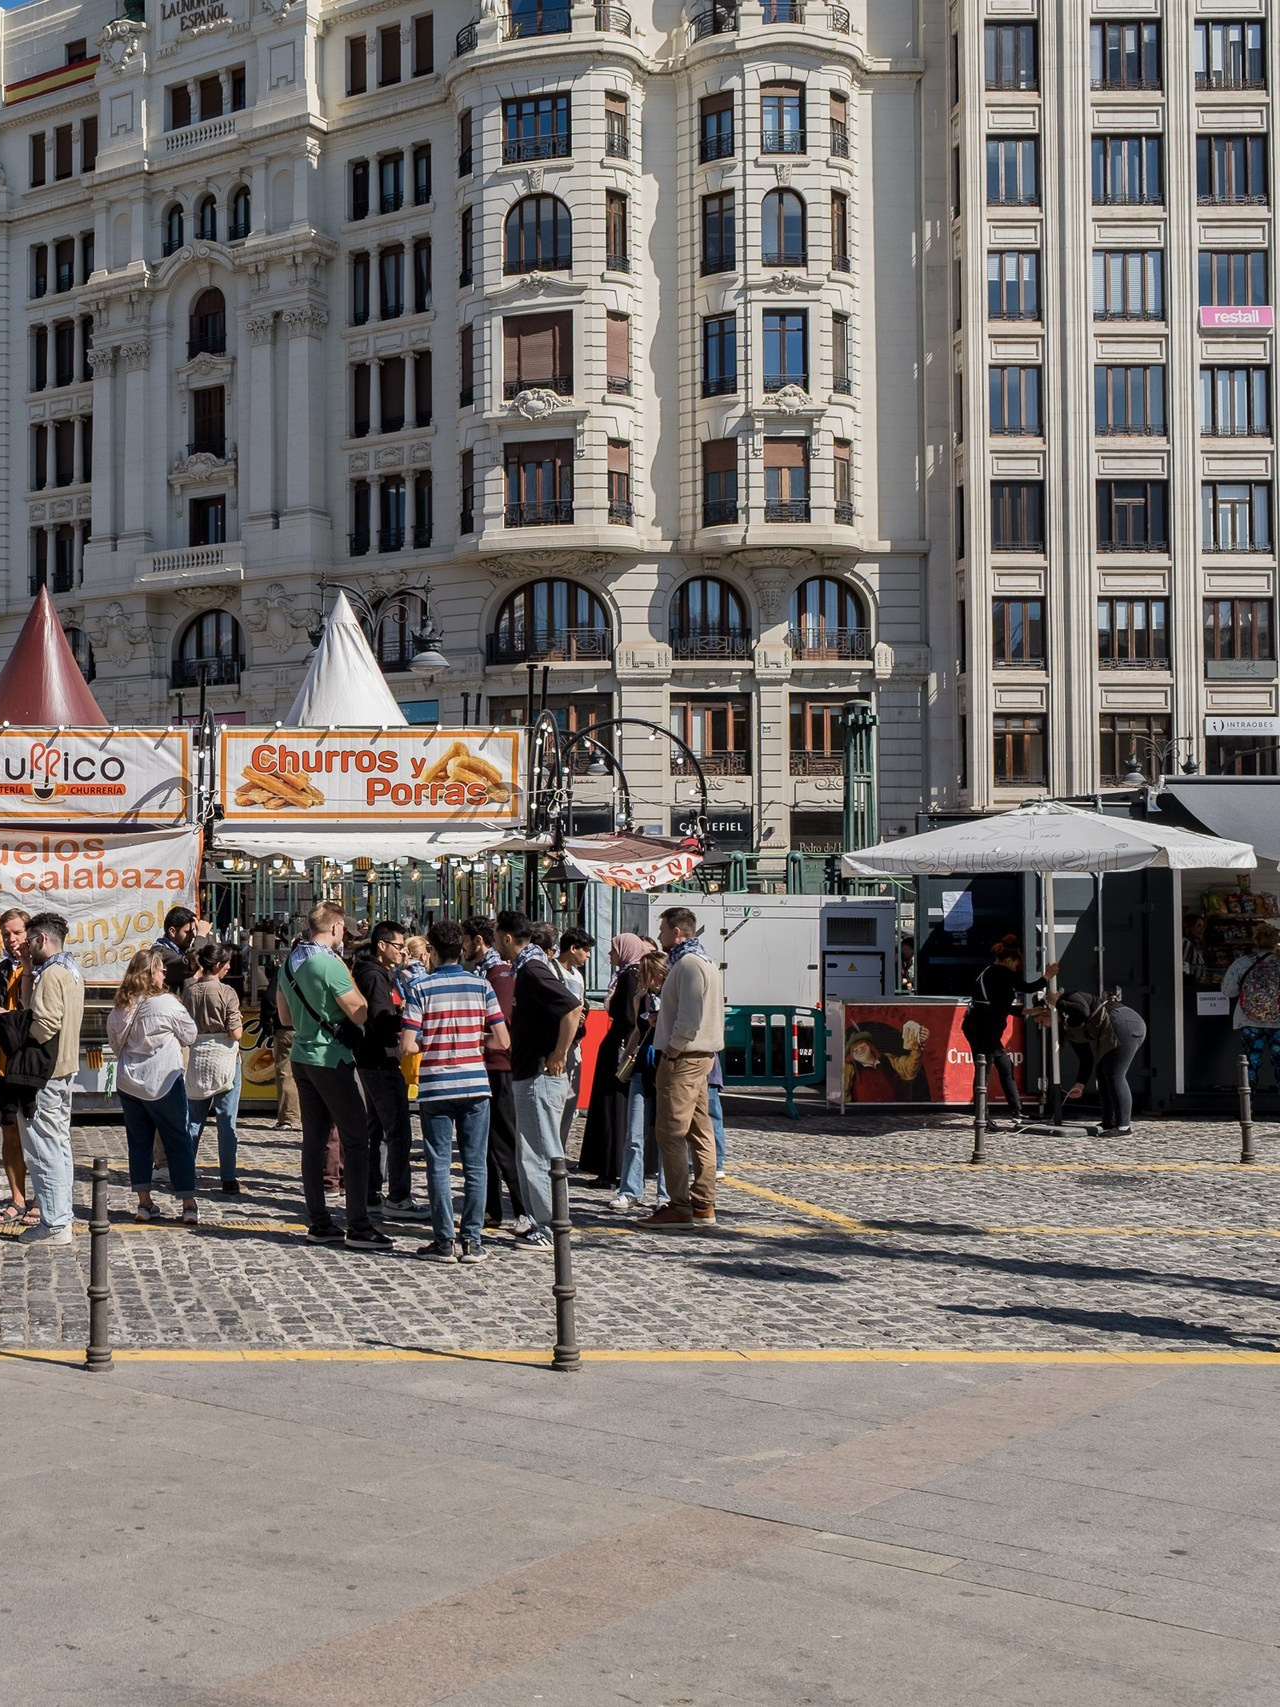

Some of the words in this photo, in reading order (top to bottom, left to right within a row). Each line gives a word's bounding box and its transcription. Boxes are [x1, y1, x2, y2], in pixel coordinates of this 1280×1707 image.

[180, 3, 228, 31] ESPAÑOL
[1214, 309, 1260, 323] restail
[251, 744, 399, 774] Churros
[410, 757, 427, 778] y
[70, 785, 123, 796] CHURRERÍA
[366, 777, 488, 806] Porras
[679, 822, 744, 832] COTEFIEL
[800, 842, 822, 852] Pedro
[15, 861, 185, 893] calabaza
